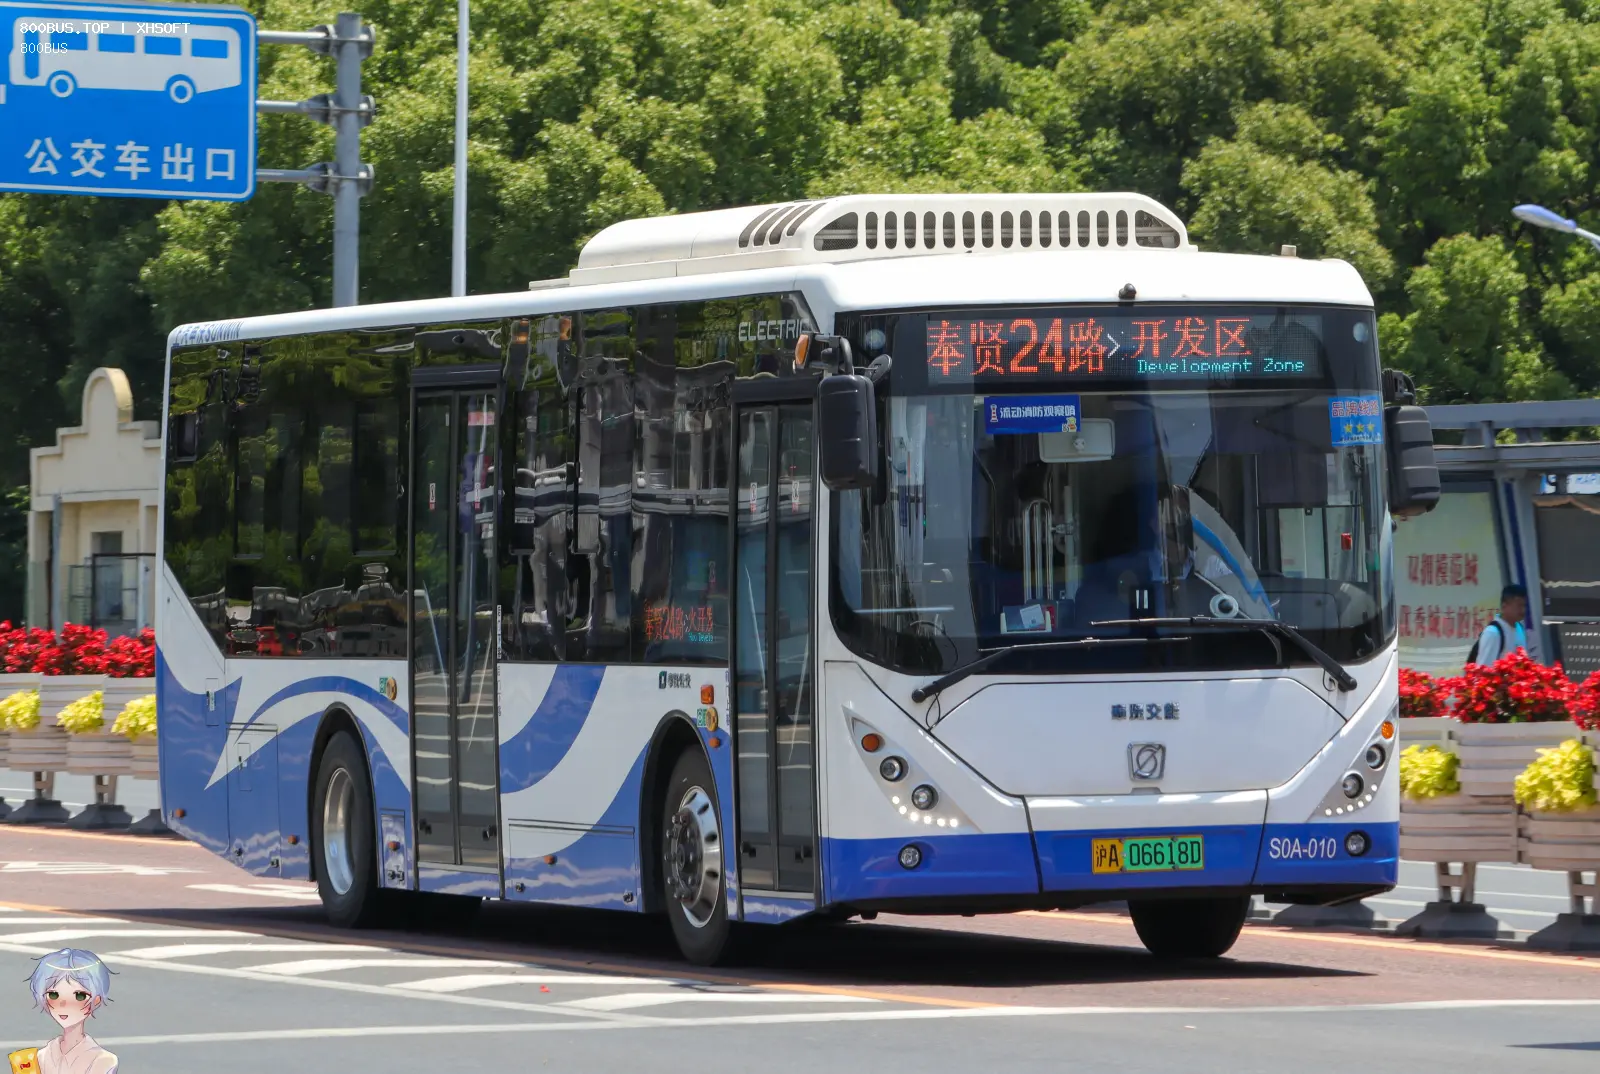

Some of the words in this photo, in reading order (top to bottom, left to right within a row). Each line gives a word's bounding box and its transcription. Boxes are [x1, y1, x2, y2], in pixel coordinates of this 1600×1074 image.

[24, 136, 236, 183] 公交车出口
[926, 318, 1108, 376] 奉贤24路
[1129, 317, 1254, 359] 开发区
[1137, 358, 1253, 374] Development
[1263, 357, 1306, 373] Zone
[999, 405, 1077, 419] 流动消防观察哨
